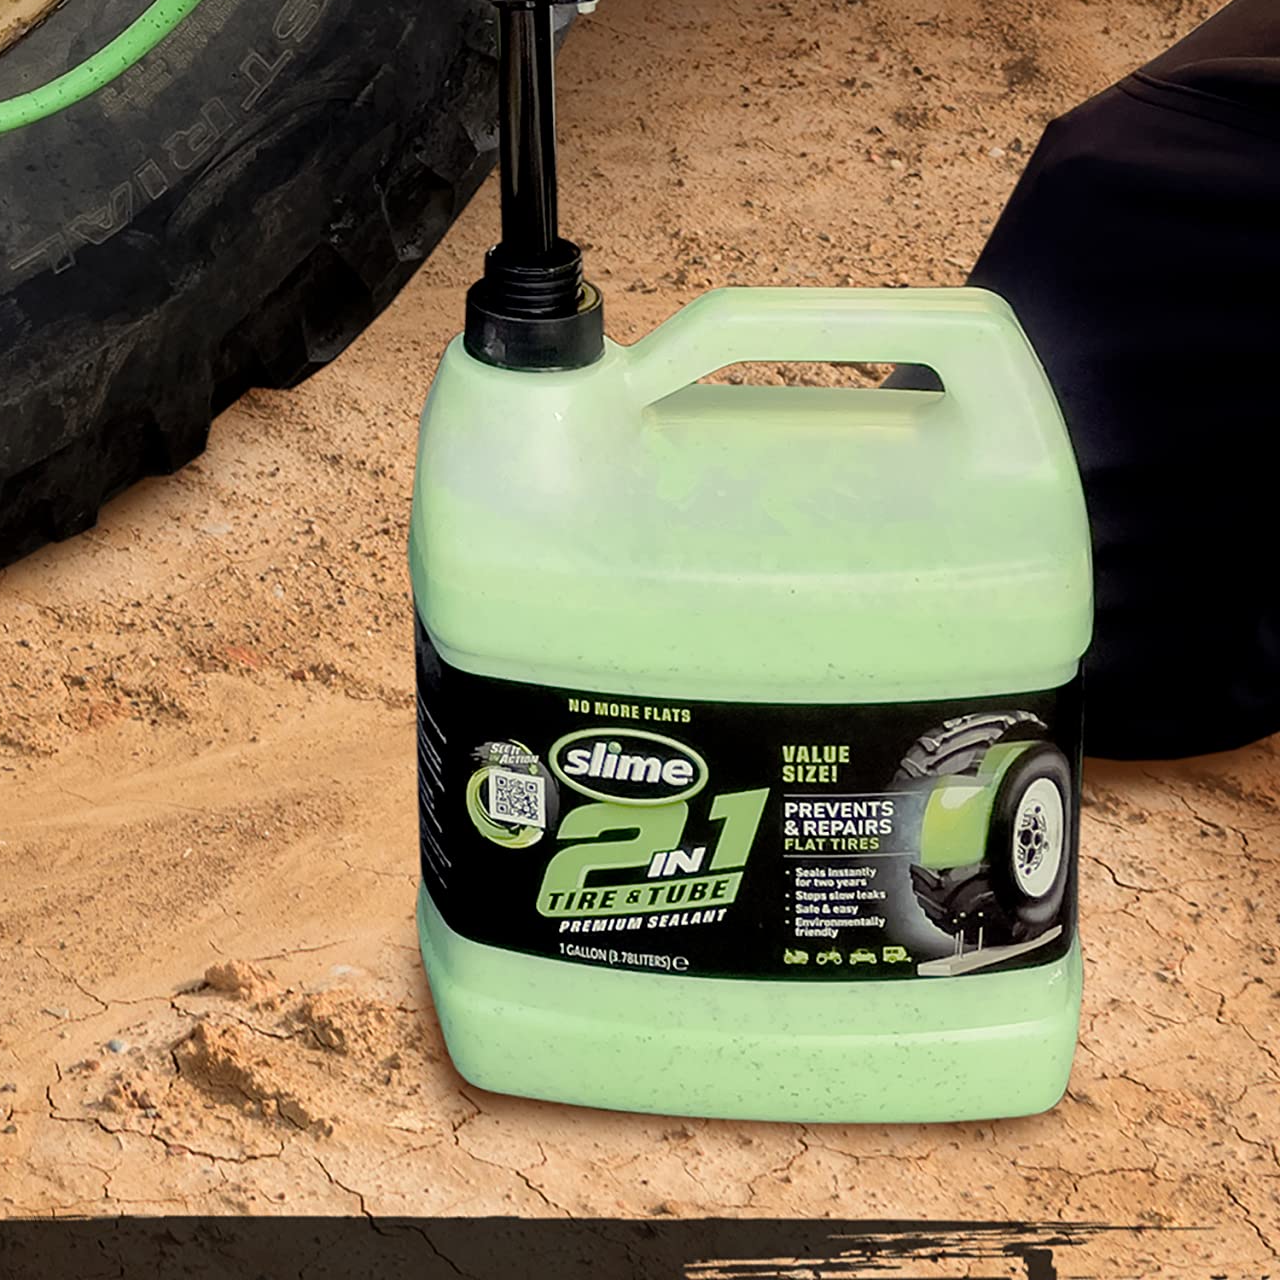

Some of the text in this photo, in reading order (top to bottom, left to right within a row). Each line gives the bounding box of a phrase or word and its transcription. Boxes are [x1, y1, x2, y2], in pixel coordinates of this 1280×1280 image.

[569, 699, 691, 722] NO MORE FLATS
[782, 745, 850, 763] VALUE
[563, 741, 693, 786] slime
[782, 765, 837, 782] SIZE!
[785, 801, 894, 818] PREVENTS
[785, 819, 892, 835] & REPAIRS
[785, 837, 879, 850] FLAT TIRES
[648, 847, 706, 878] IN
[796, 877, 867, 889] for two years
[548, 879, 729, 911] TIRE & TUBE
[796, 890, 885, 901] Stops slow leaks
[796, 904, 820, 914] Safe
[834, 905, 859, 916] easy
[559, 909, 727, 932] PREMIUM SEALANT
[795, 916, 885, 928] Environmentally
[795, 927, 838, 938] friendly
[566, 944, 607, 961] GALLON
